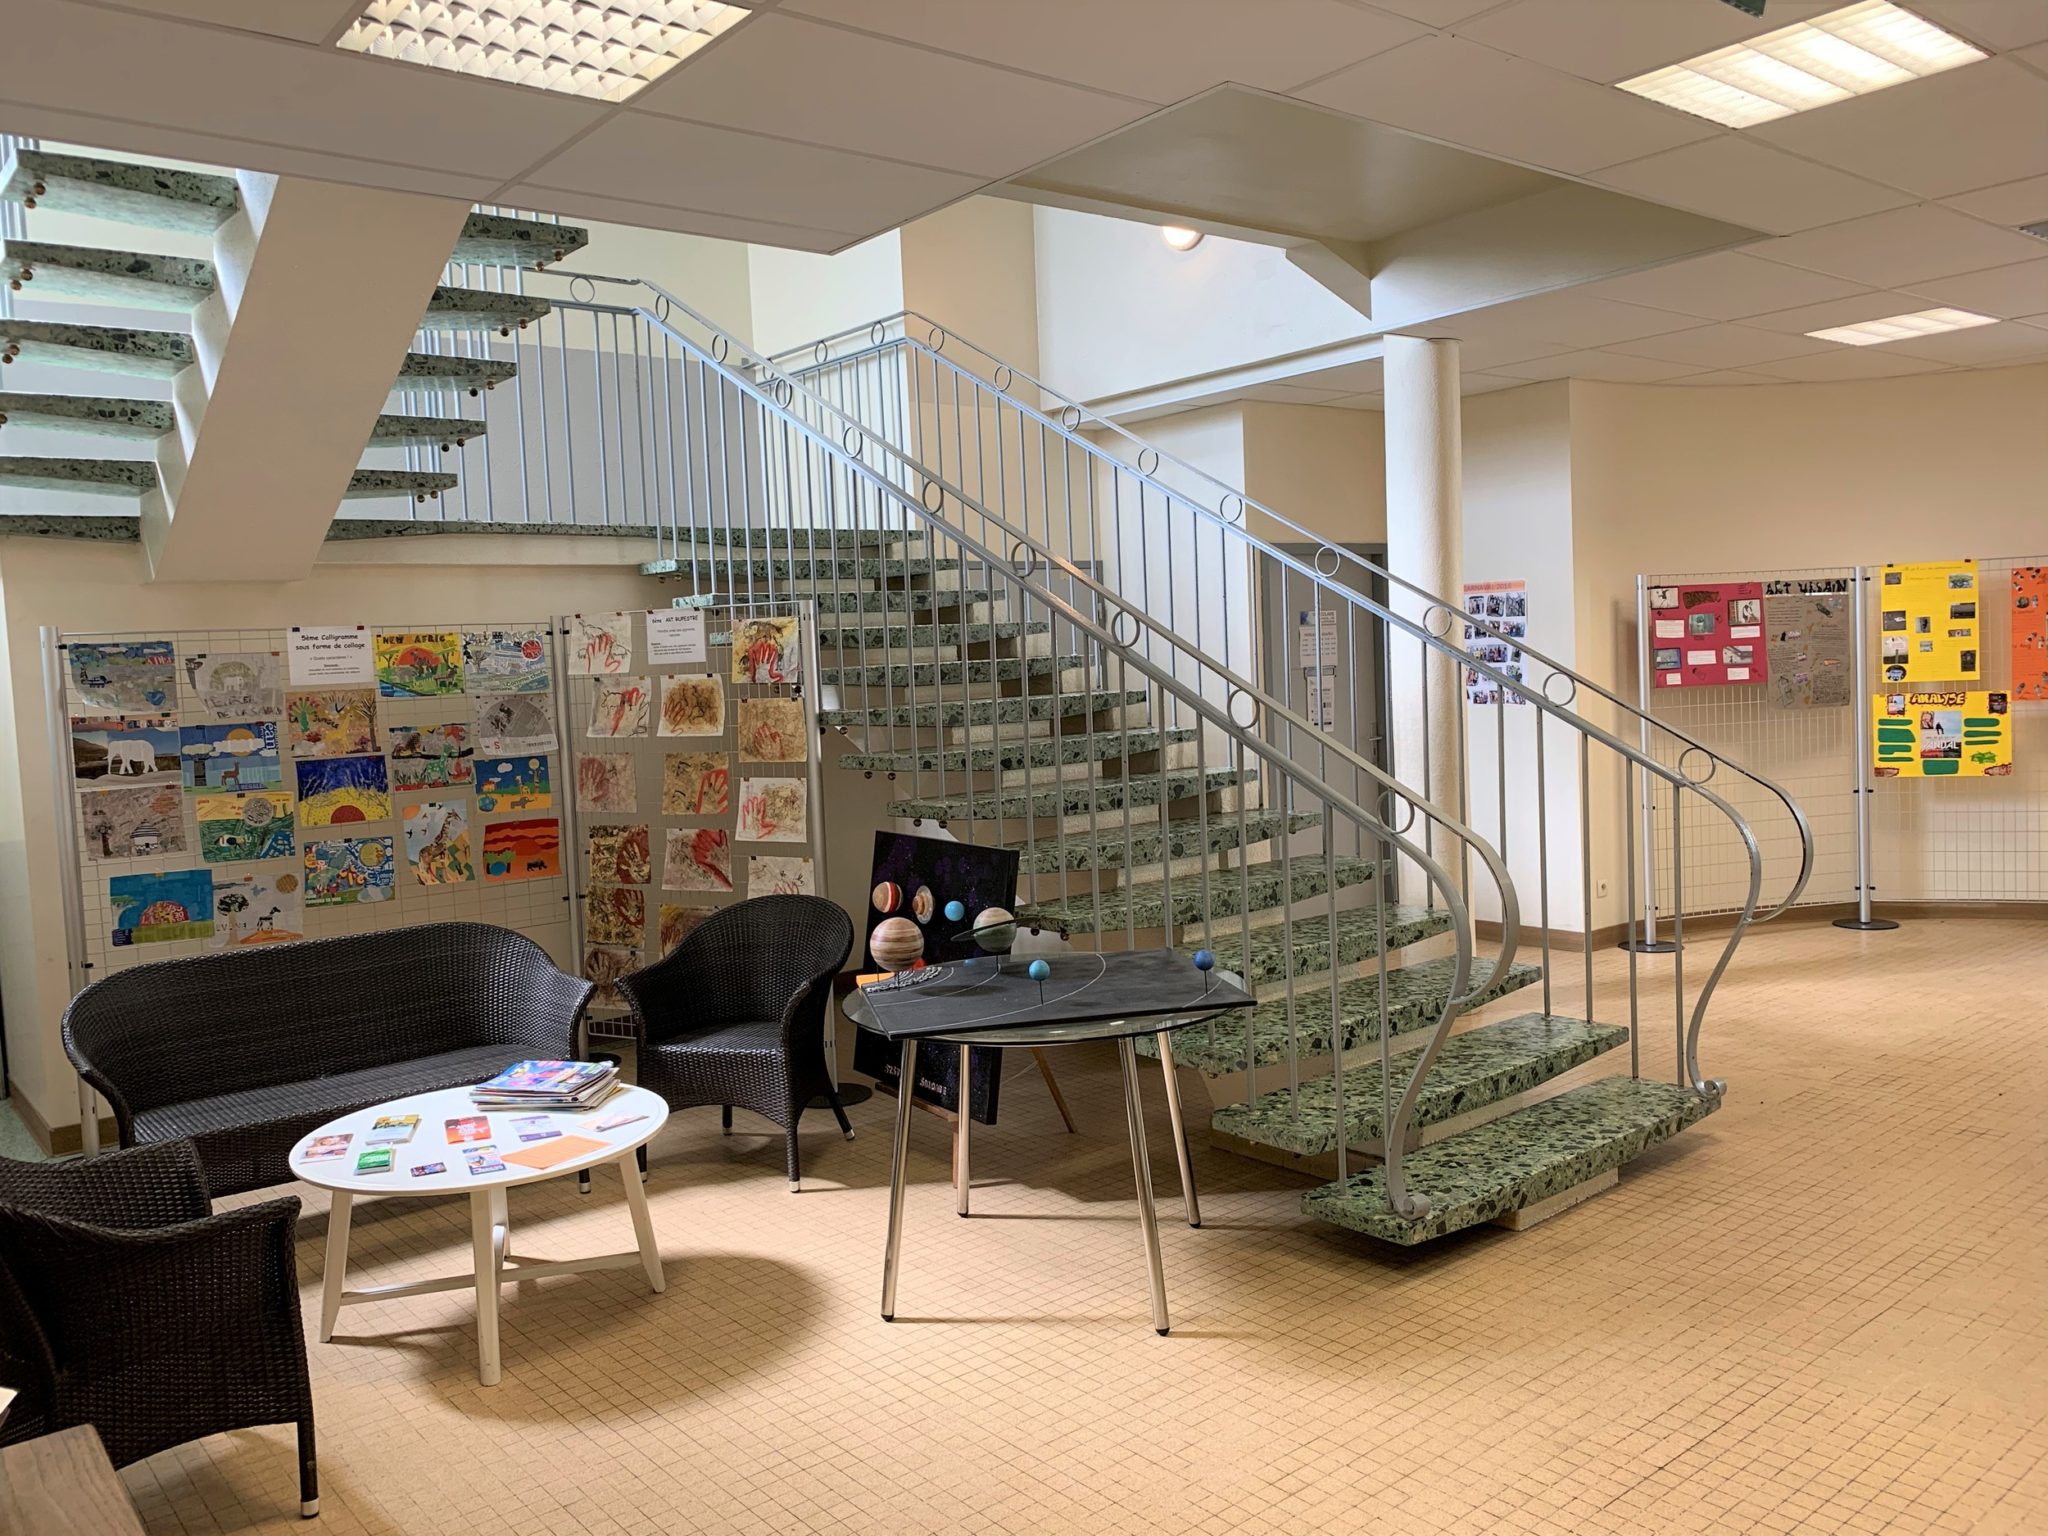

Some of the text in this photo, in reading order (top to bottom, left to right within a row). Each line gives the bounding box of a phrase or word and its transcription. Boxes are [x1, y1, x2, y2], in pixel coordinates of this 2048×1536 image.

[382, 635, 404, 645] NEW
[344, 642, 365, 650] collage
[1910, 692, 1965, 706] ANALYSE
